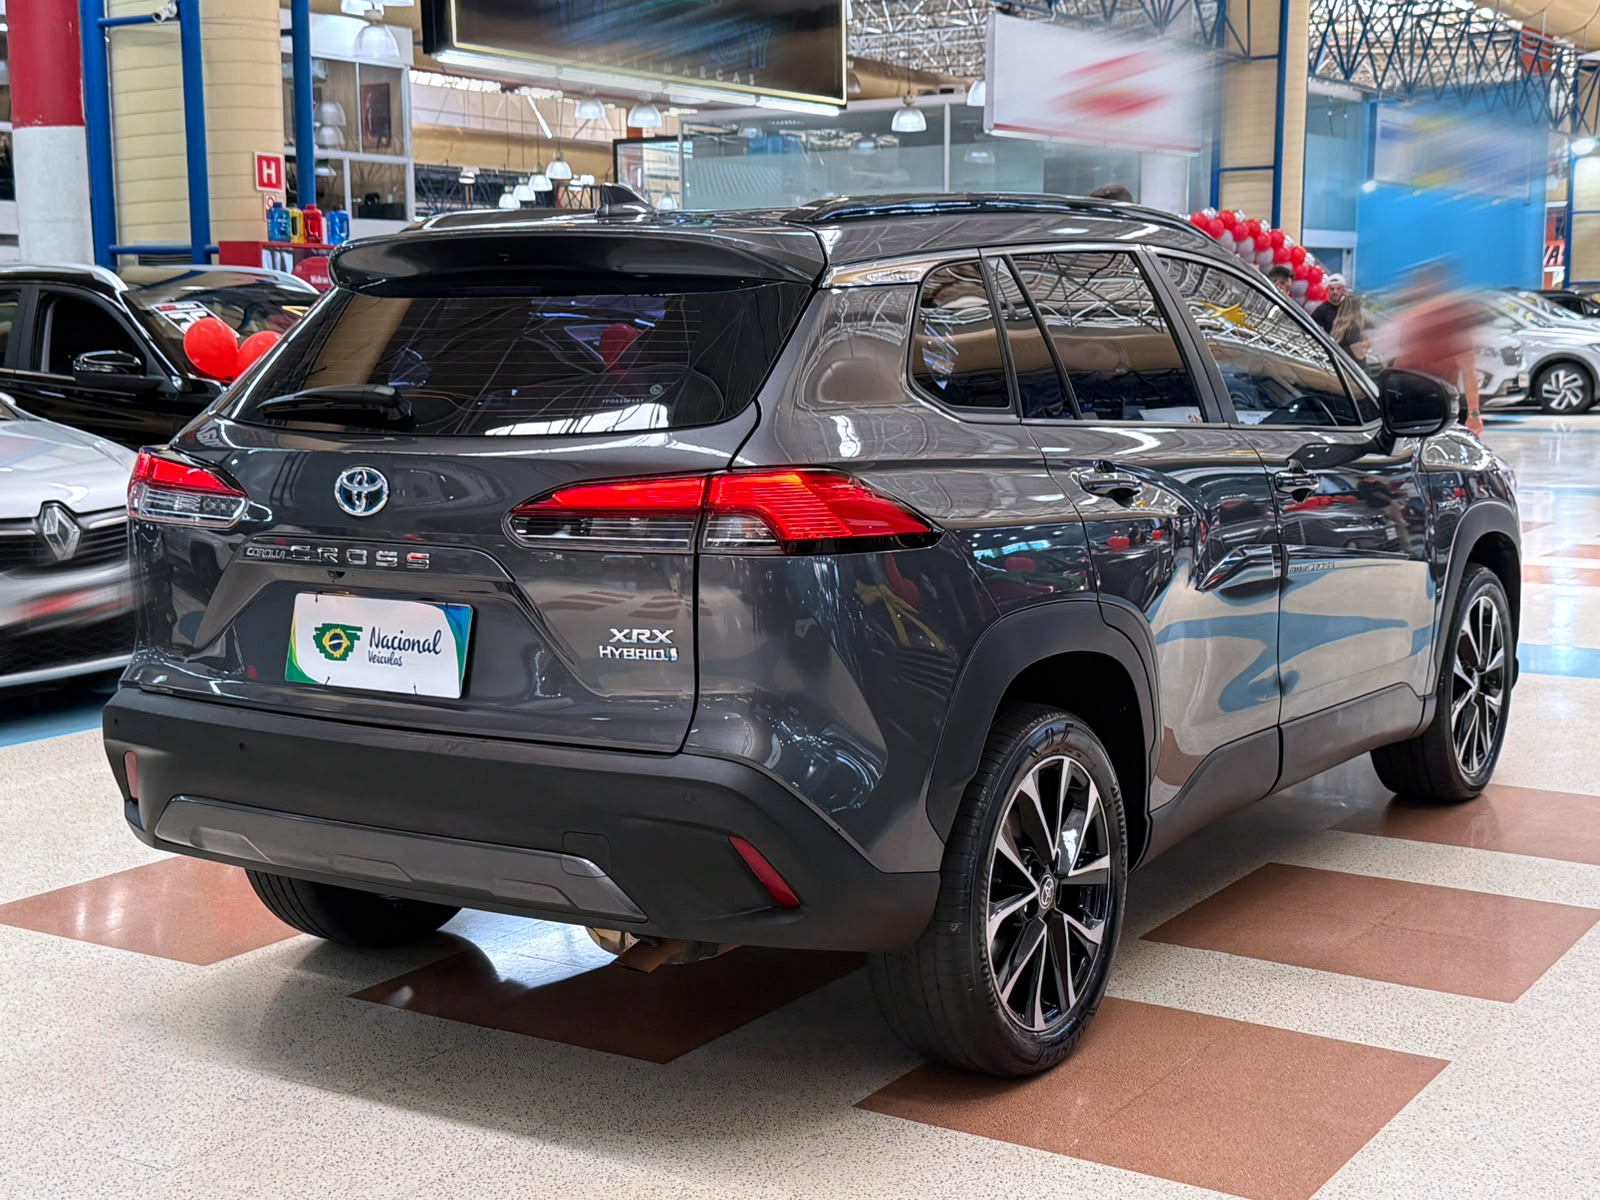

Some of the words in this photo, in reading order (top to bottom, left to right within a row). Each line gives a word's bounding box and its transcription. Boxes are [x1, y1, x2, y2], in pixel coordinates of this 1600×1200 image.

[262, 160, 277, 184] H
[290, 545, 430, 569] CROSS
[369, 626, 442, 655] Nacional
[609, 628, 674, 644] XRX
[598, 645, 666, 661] HYBRID
